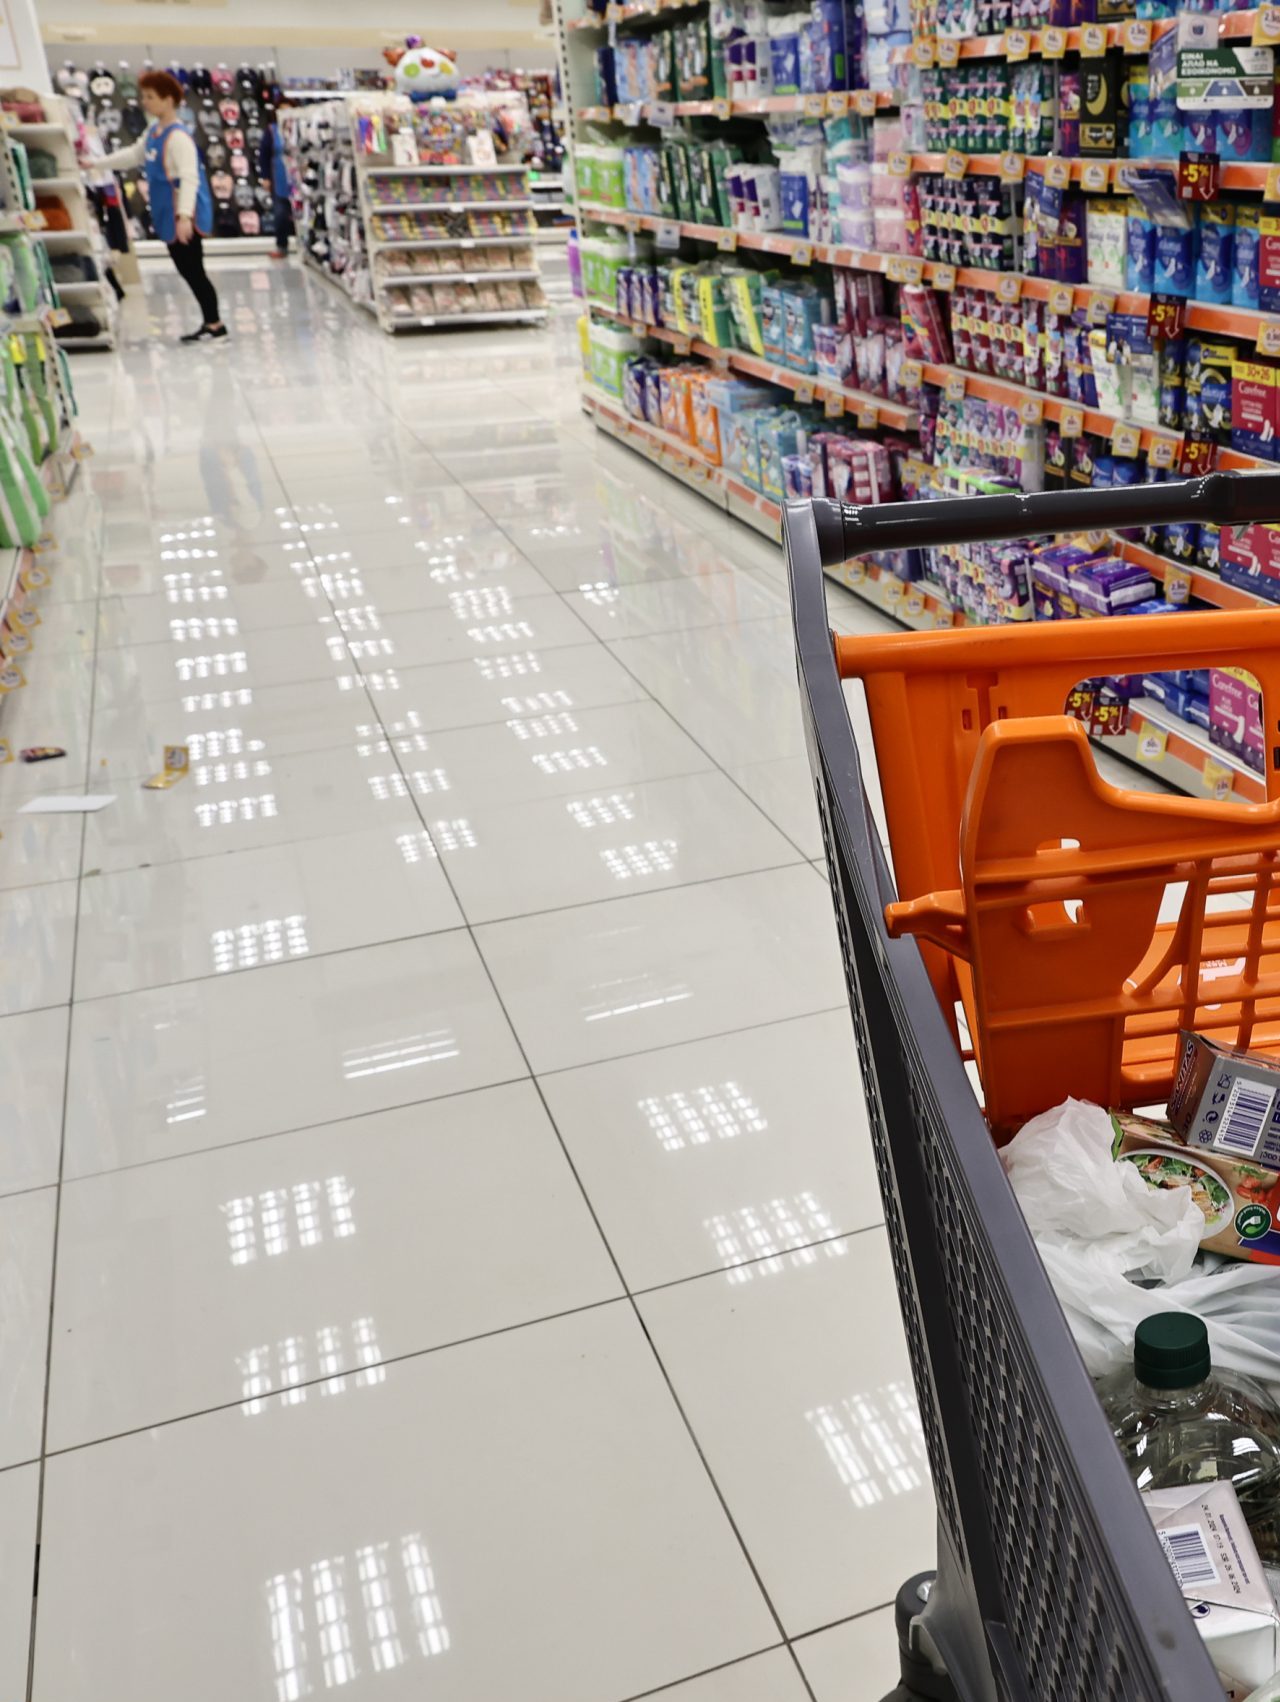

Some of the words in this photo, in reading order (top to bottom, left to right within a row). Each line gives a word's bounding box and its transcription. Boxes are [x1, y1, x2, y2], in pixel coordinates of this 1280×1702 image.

[1152, 305, 1175, 322] -5%
[1238, 381, 1267, 398] Carefree
[1186, 442, 1208, 459] -5%
[1212, 674, 1243, 698] Carefree
[1069, 692, 1091, 708] -5%
[1094, 706, 1118, 722] -5%
[1259, 1150, 1277, 1162] σας!
